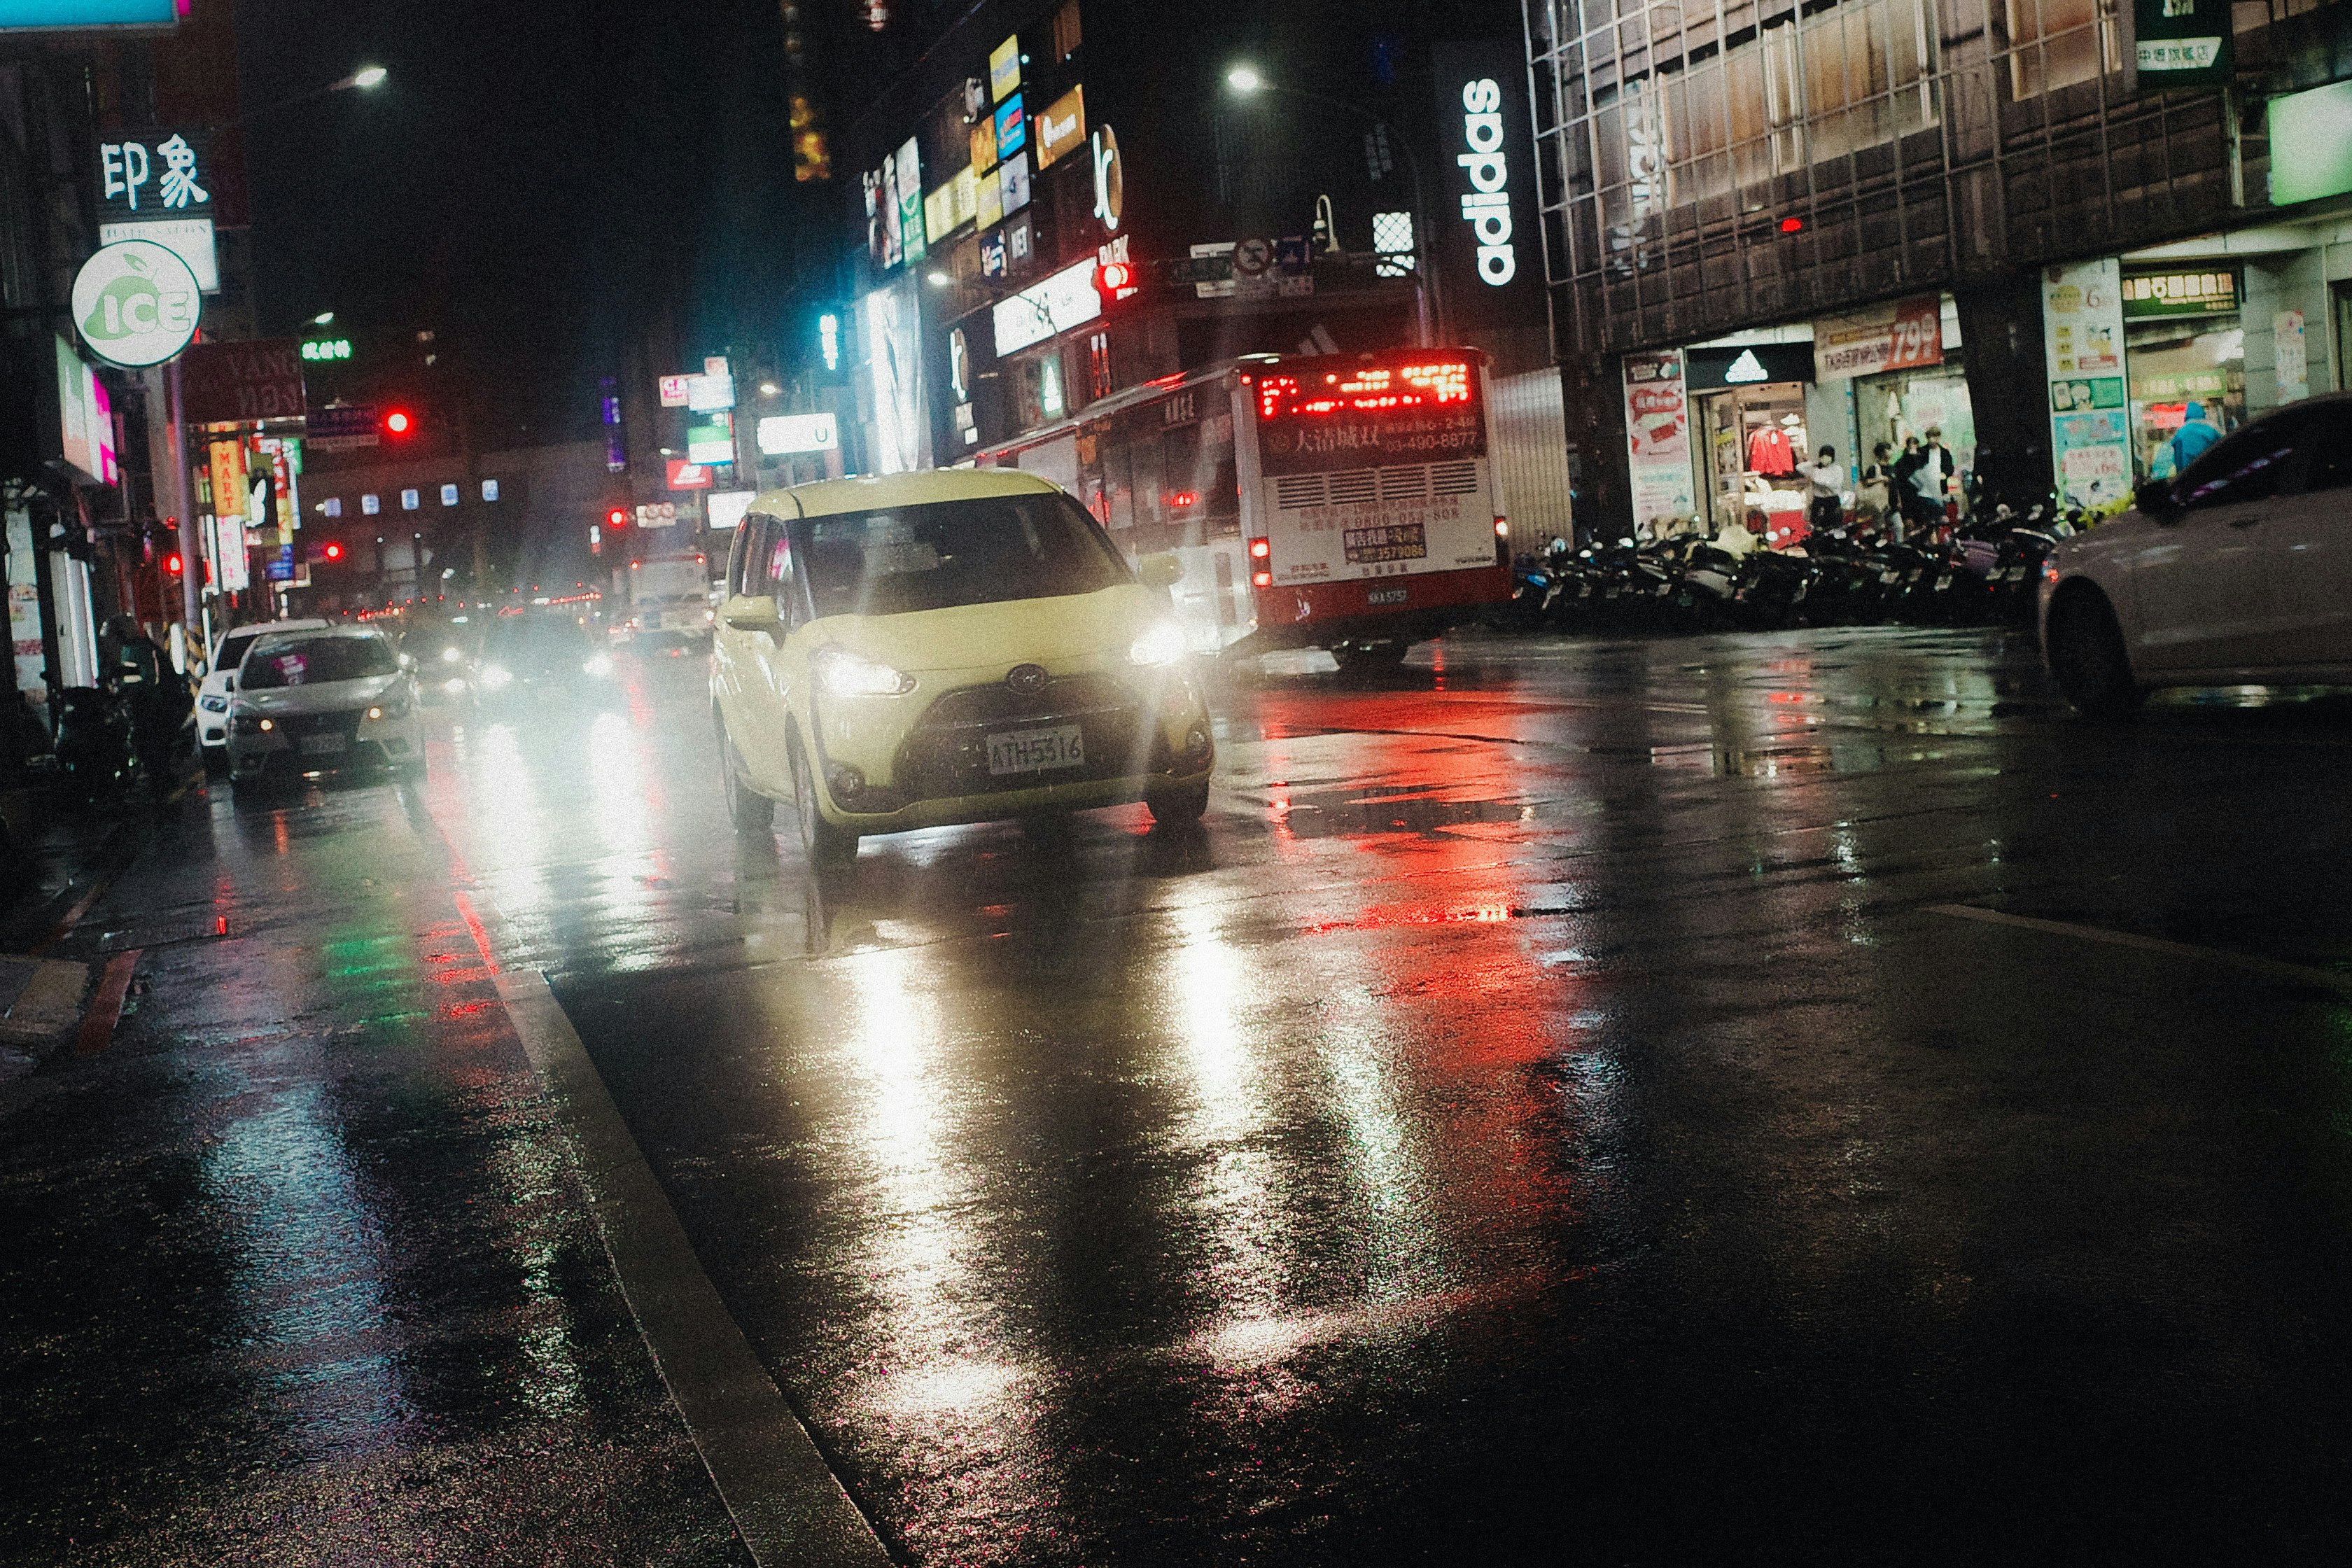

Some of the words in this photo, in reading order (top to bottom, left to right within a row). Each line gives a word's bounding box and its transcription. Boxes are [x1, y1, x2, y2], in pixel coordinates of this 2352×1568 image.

[100, 132, 209, 211] 印象
[1457, 78, 1516, 286] adidas
[104, 291, 191, 335] ICE
